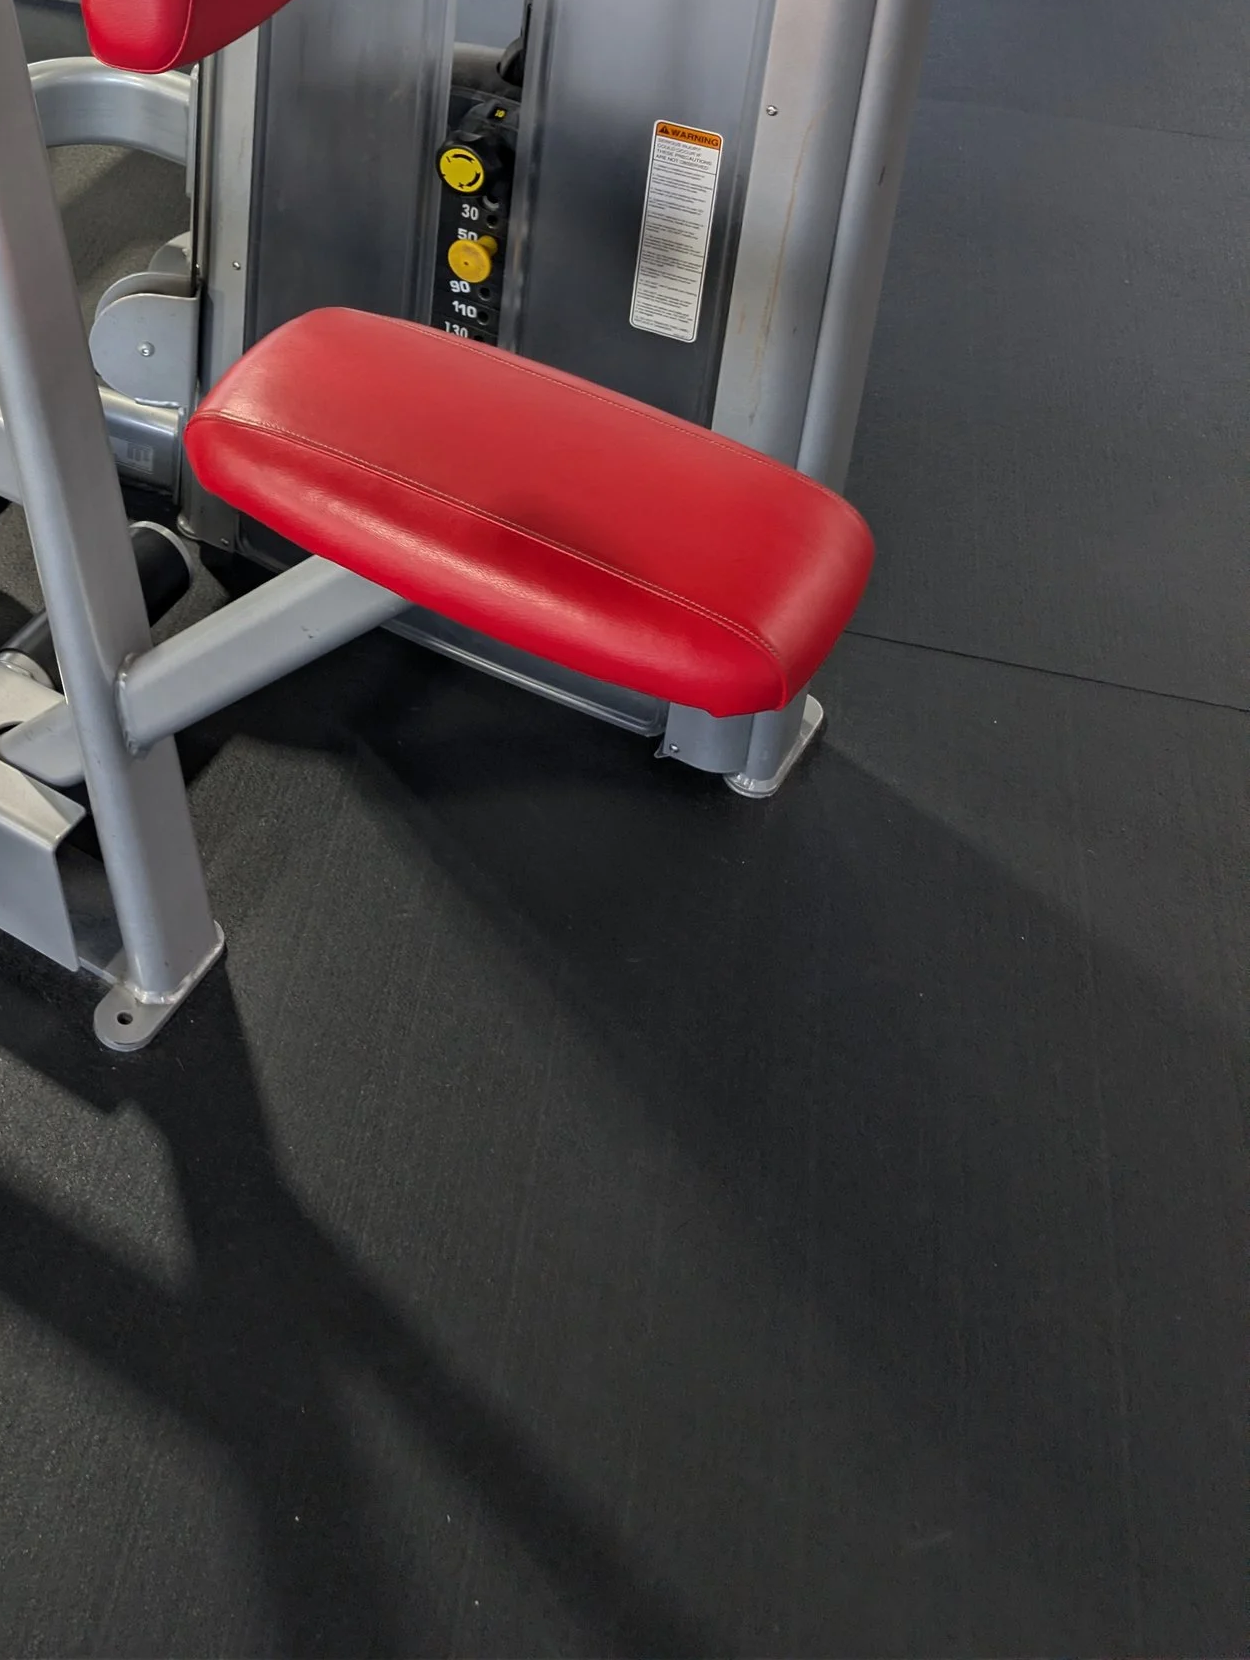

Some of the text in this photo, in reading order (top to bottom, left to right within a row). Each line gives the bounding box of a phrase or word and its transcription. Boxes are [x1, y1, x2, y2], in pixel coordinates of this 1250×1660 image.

[671, 129, 718, 146] WARNING
[461, 203, 479, 221] 30
[457, 227, 478, 242] 50
[449, 280, 471, 294] 90
[452, 300, 477, 318] 110
[444, 321, 469, 339] 130
